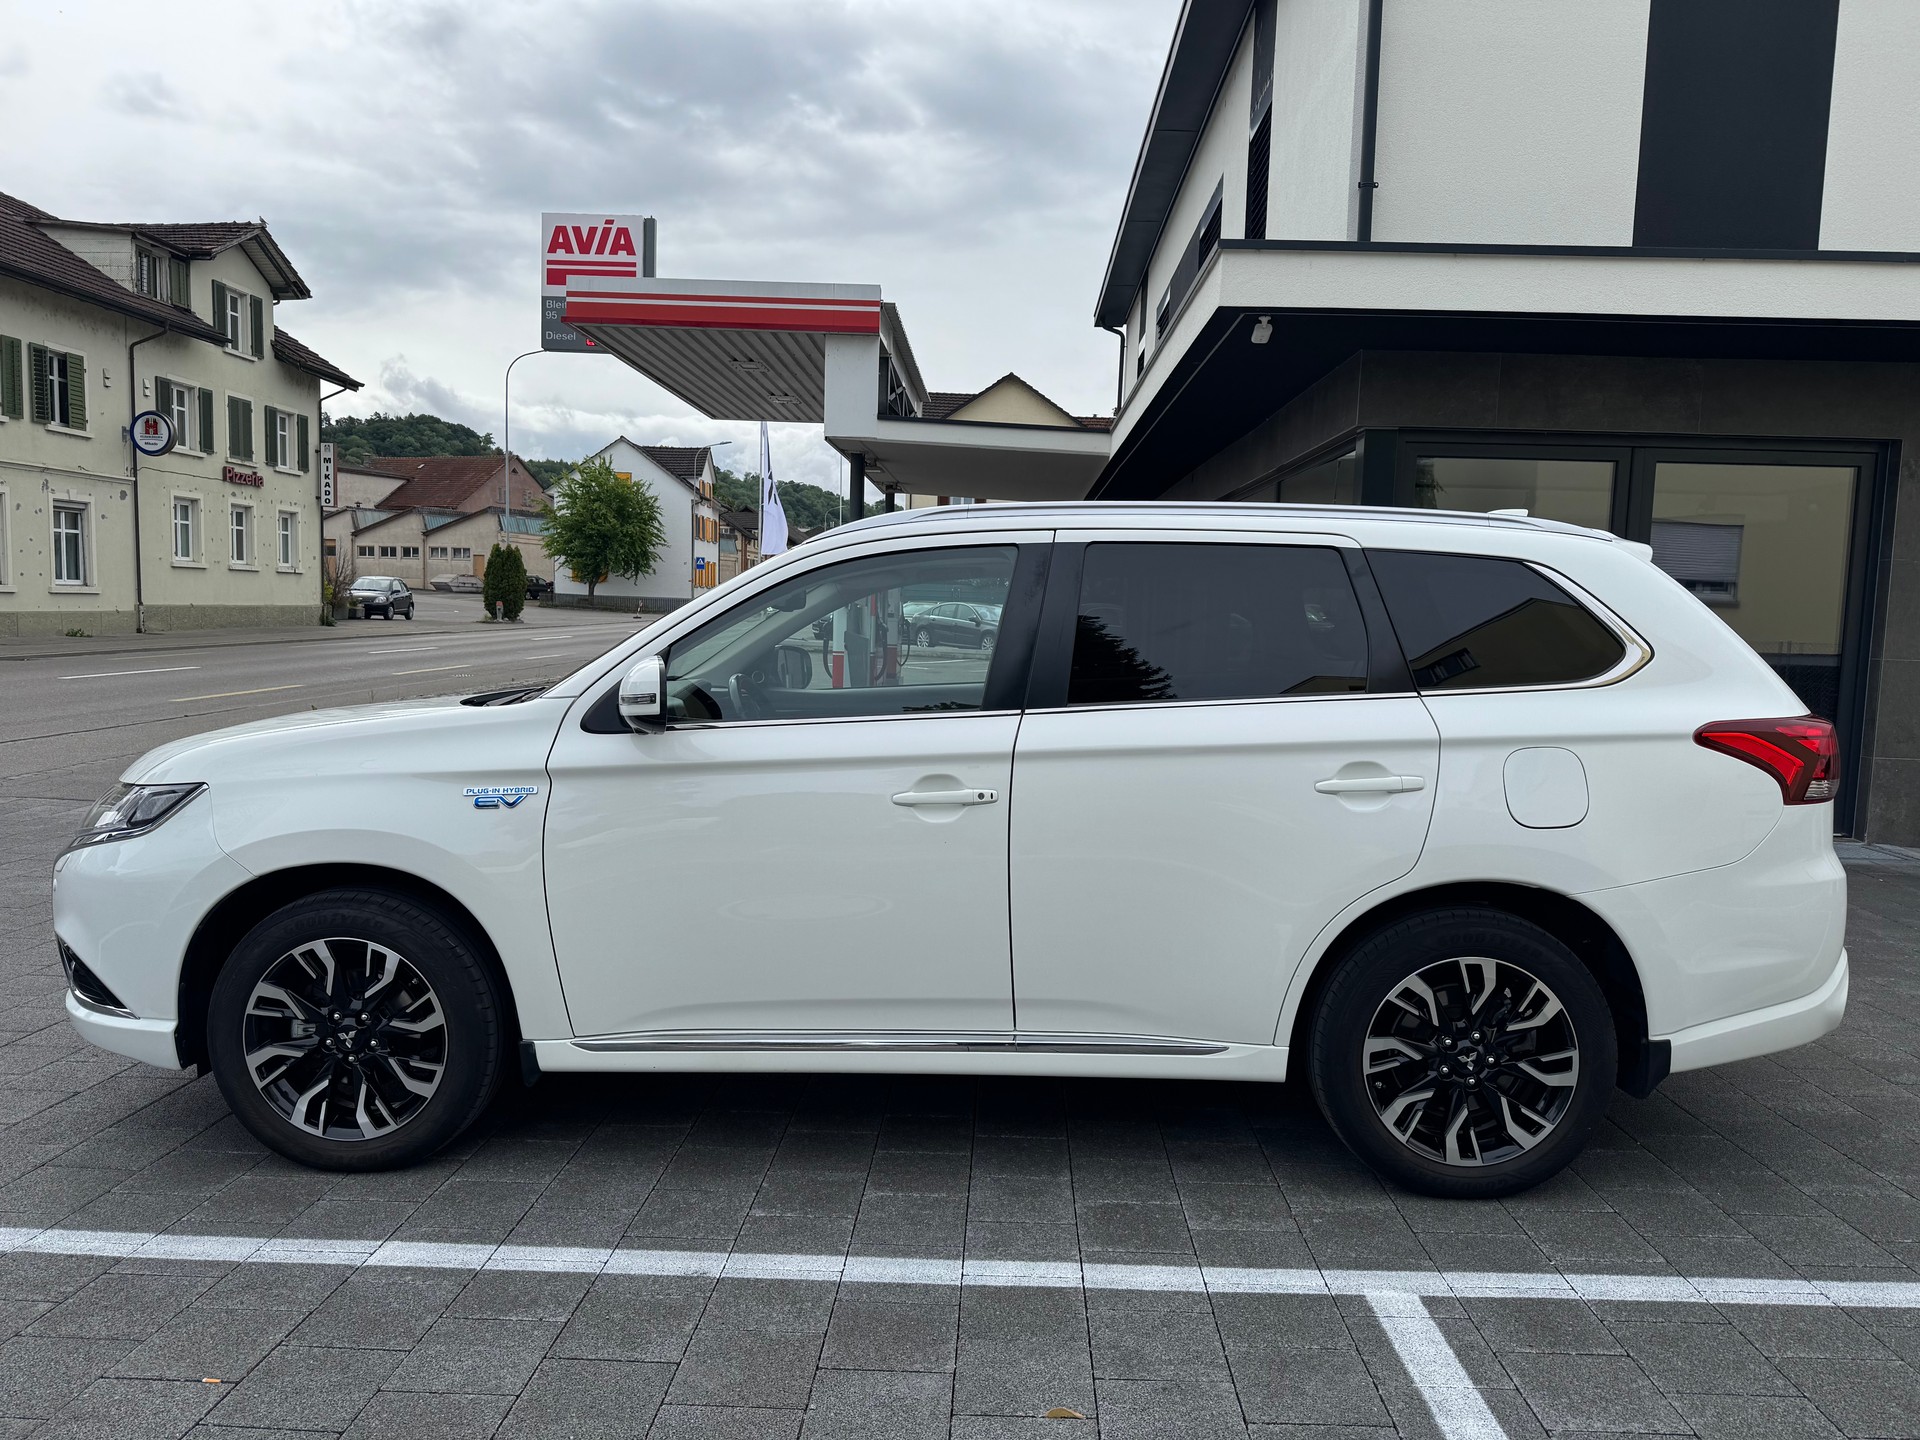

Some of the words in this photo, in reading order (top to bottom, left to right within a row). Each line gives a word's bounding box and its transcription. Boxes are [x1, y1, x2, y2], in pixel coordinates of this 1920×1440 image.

[545, 310, 558, 320] 95
[545, 331, 576, 341] Diesel
[224, 465, 265, 489] Pizzeria
[323, 457, 332, 505] MIKADO
[502, 786, 535, 794] HYBRID
[473, 794, 528, 809] EV
